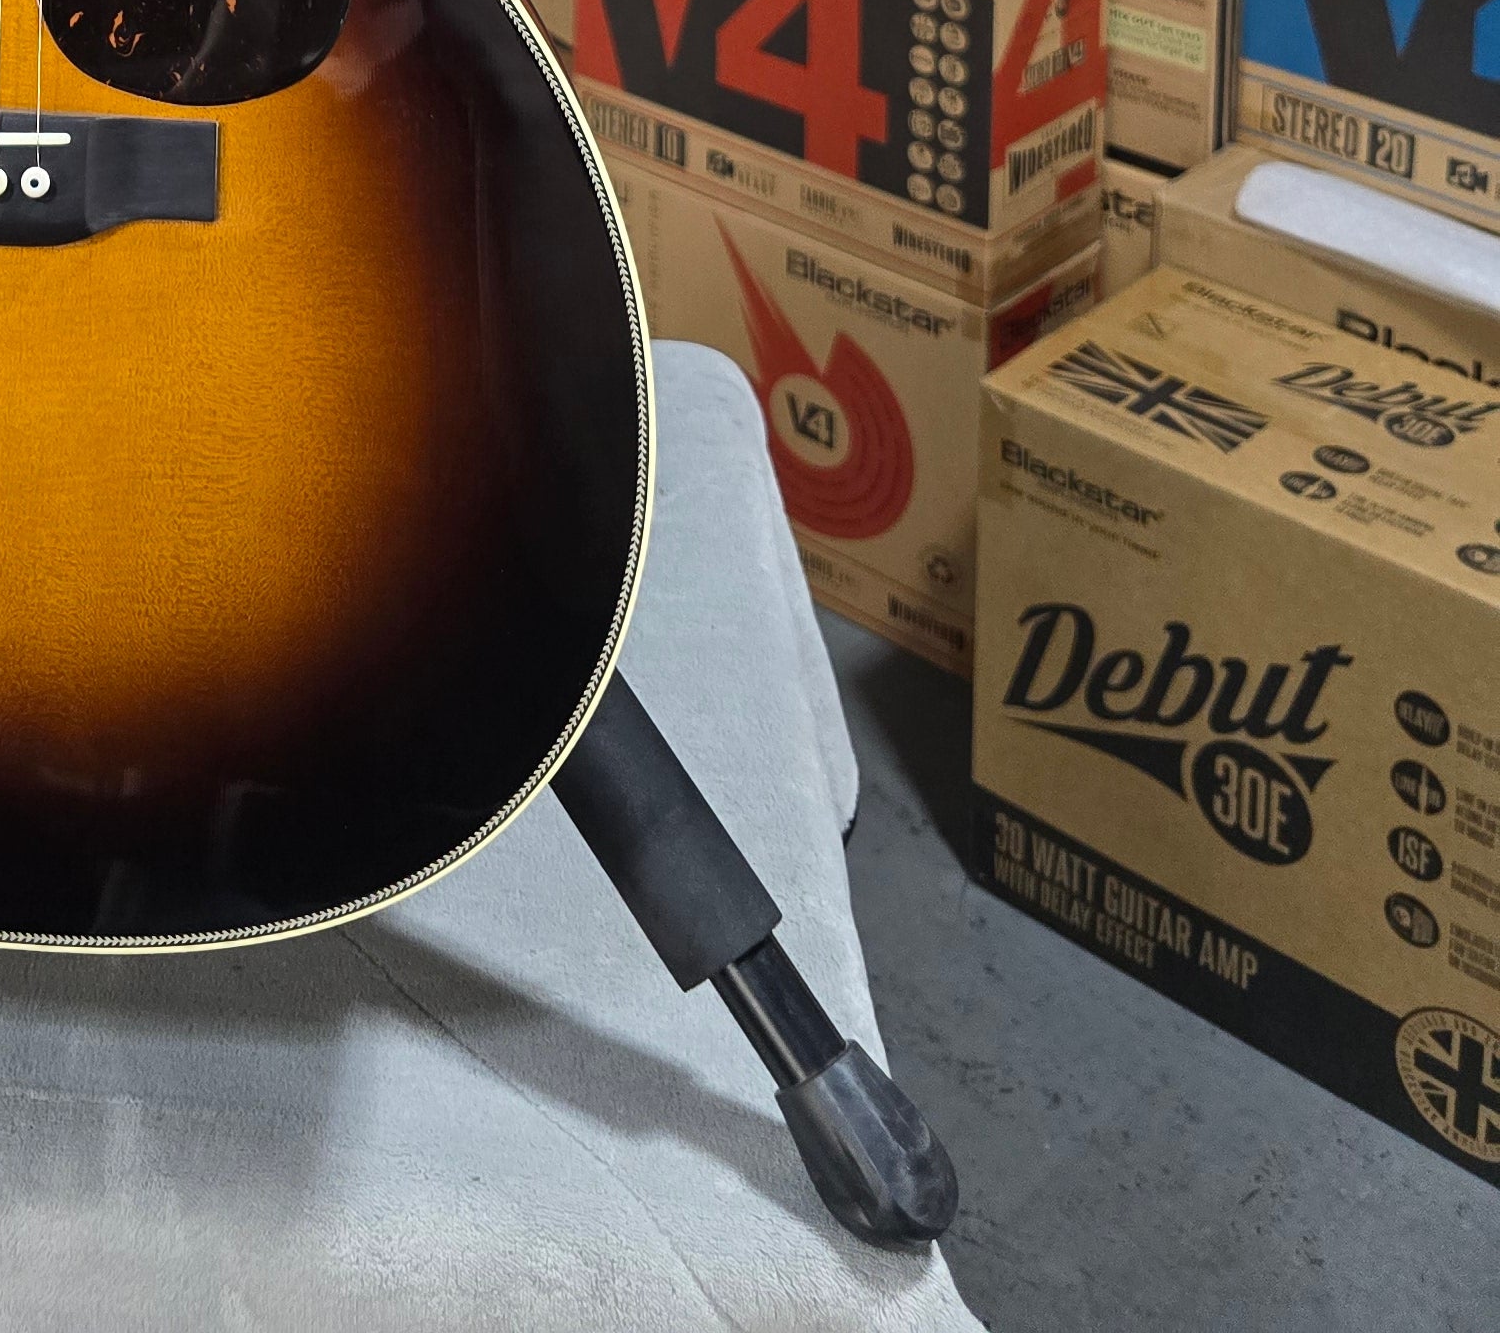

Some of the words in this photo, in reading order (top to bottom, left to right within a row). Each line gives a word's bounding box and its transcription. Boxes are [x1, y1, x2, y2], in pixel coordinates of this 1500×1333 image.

[1273, 92, 1359, 159] STEREO
[1375, 128, 1410, 176] 20
[786, 245, 940, 336] Blackstar
[1001, 439, 1160, 527] Blackstar
[1003, 601, 1354, 745] Debut
[1212, 753, 1291, 856] 30E
[995, 811, 1025, 861] 30
[1031, 830, 1097, 902] WATT
[1103, 873, 1192, 960] GUITAR
[1199, 929, 1259, 990] AMP
[1400, 832, 1433, 878] ISF
[1040, 874, 1092, 933] DELAY
[1095, 910, 1156, 969] EFFECT
